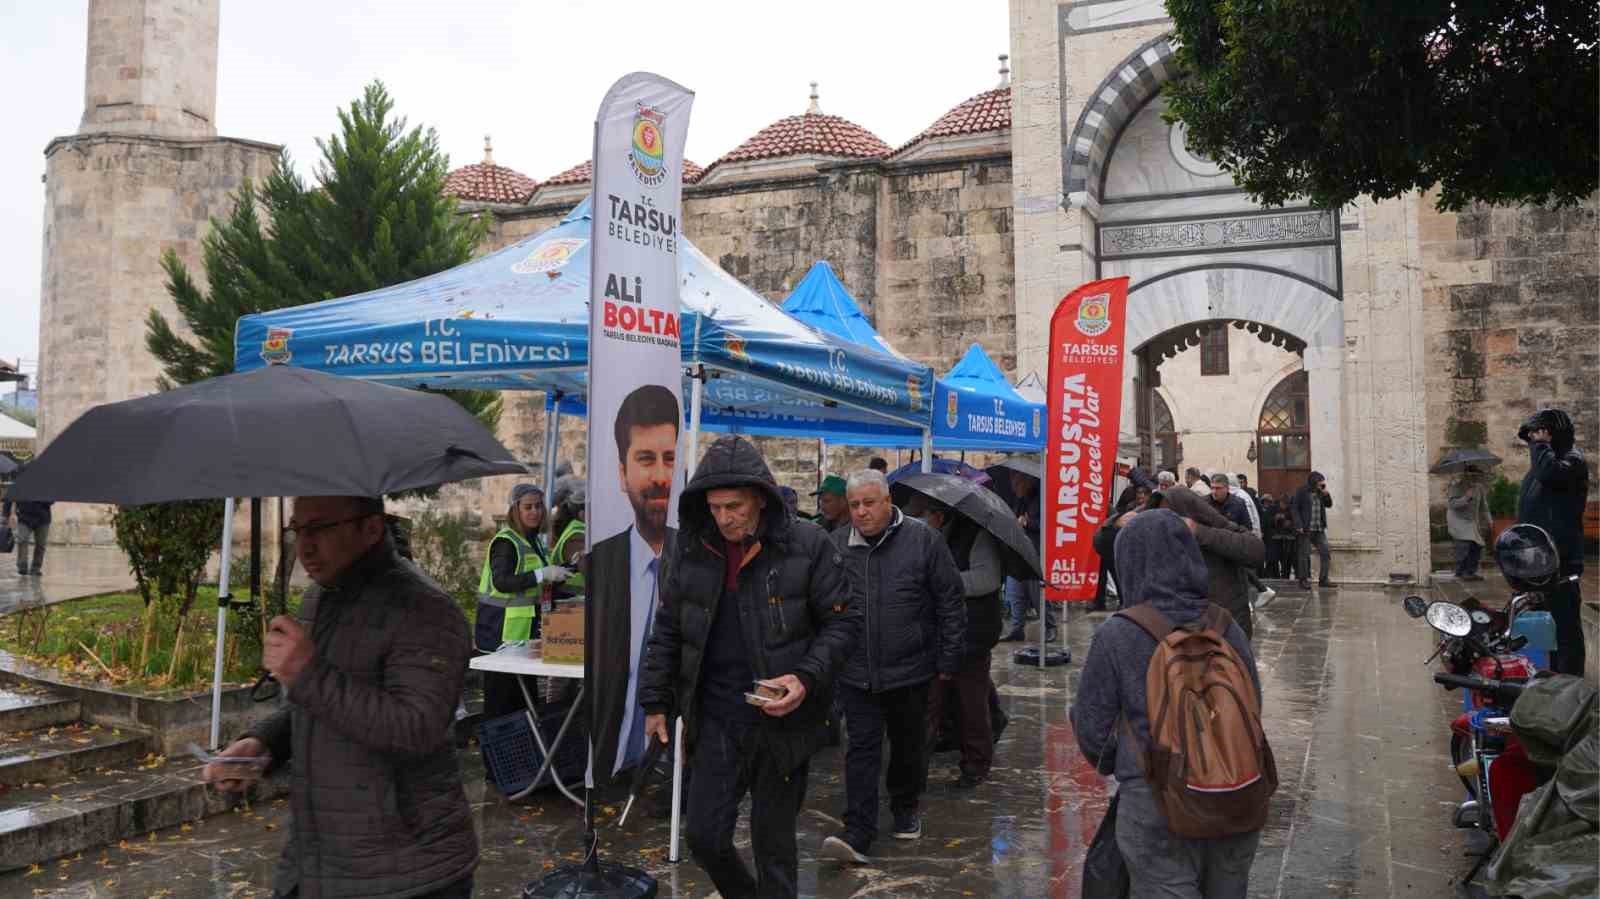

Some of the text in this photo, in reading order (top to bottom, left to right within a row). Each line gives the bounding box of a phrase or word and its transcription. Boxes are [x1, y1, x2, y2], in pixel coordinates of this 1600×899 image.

[604, 273, 642, 304] ALİ
[603, 301, 679, 337] BOLTA
[324, 337, 571, 365] TARSUS BELEDİYESİ
[1062, 343, 1119, 357] TARSUS
[1079, 385, 1100, 428] Var
[968, 414, 993, 433] TARSUS
[1056, 373, 1086, 547] TARSUS'TA
[1052, 557, 1076, 571] ALİ
